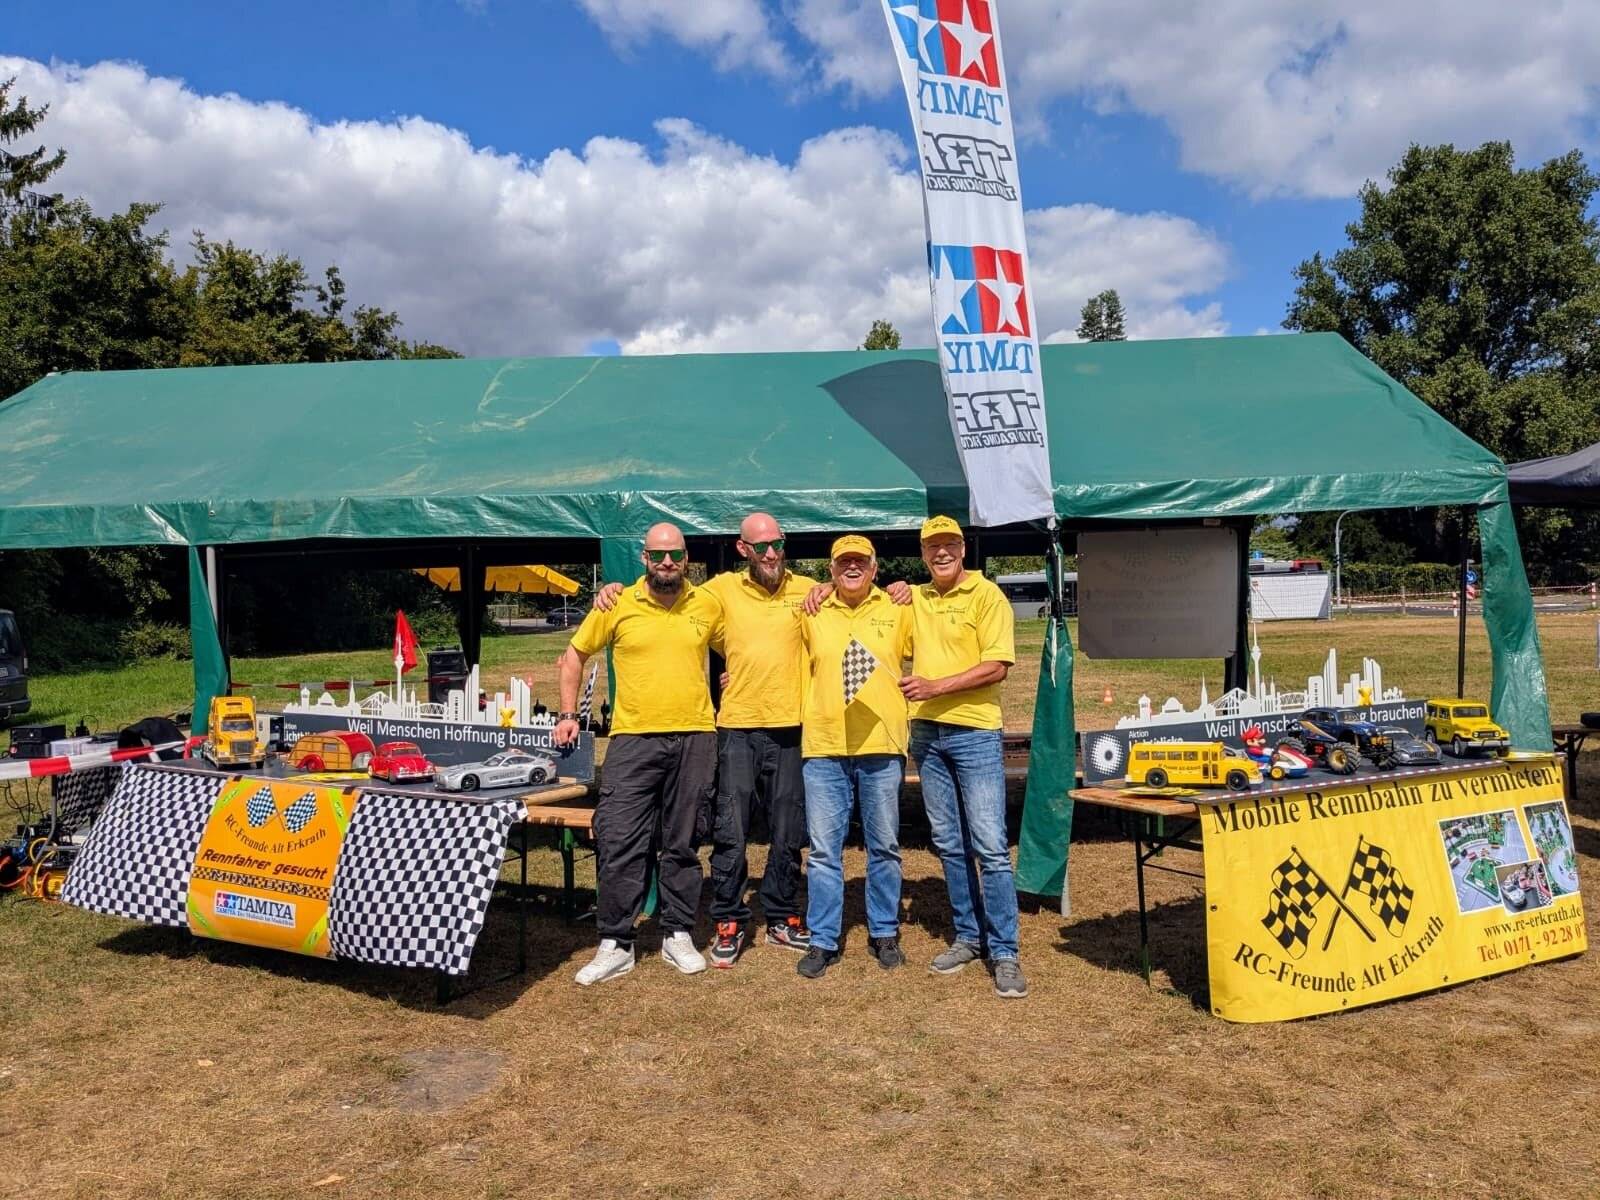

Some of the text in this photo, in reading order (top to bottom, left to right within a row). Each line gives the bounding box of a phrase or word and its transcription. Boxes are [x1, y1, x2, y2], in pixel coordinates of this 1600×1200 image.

[347, 718, 374, 734] Weil
[377, 720, 441, 740] Menschen
[444, 724, 506, 748] Hoffnung
[1128, 730, 1149, 739] Aktion
[1205, 719, 1236, 739] Weil
[1211, 761, 1561, 834] Mobile Rennbahn zu vermieten!
[224, 814, 327, 854] RC-Freunde Alt Erkrath
[201, 849, 329, 881] Rennfahrer gesucht
[237, 895, 294, 920] TAMIYA
[1483, 903, 1581, 938] www.rc-erkrath.de
[1232, 914, 1445, 993] RC-Freunde Alt Erkrath
[1477, 943, 1502, 963] Tel.
[1503, 935, 1531, 957] 0171
[1543, 930, 1558, 947] 92
[1560, 926, 1573, 943] 28
